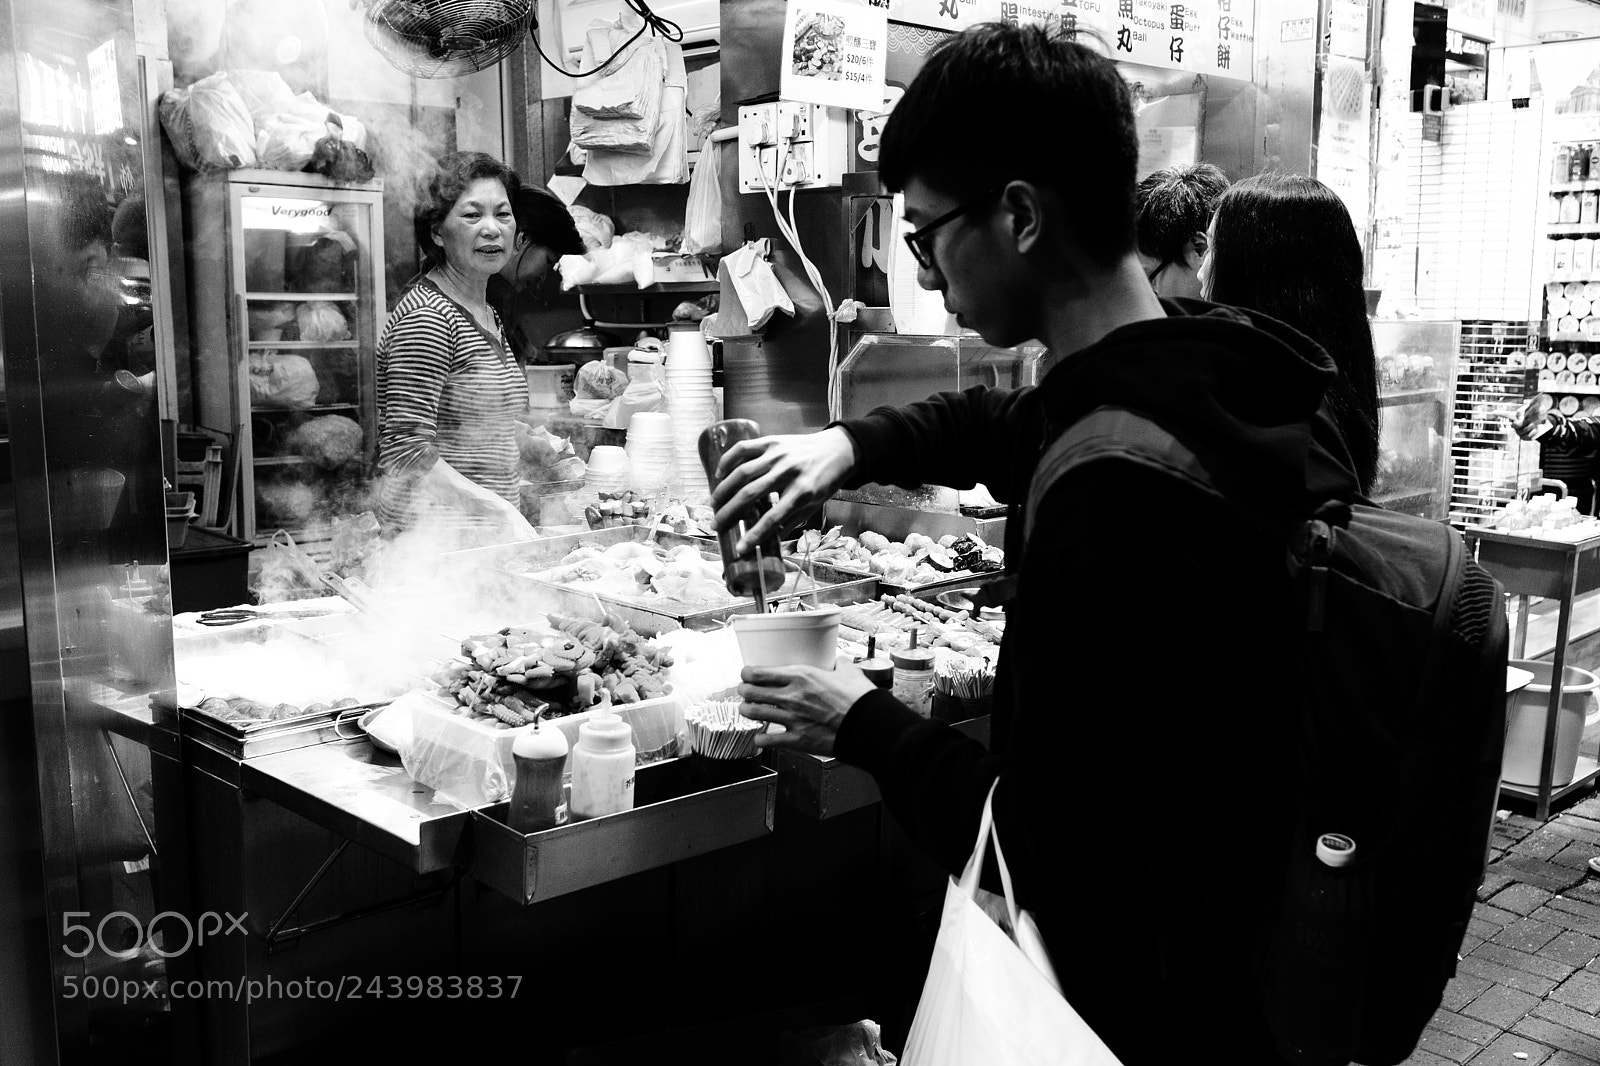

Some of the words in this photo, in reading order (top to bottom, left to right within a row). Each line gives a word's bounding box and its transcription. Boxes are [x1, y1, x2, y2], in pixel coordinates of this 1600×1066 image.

[1020, 5, 1059, 20] Intestine
[1185, 7, 1198, 19] Egg
[1133, 15, 1165, 30] Octopus
[1133, 31, 1147, 42] Ball
[1169, 4, 1184, 63] 蛋仔
[271, 204, 333, 218] Verygood
